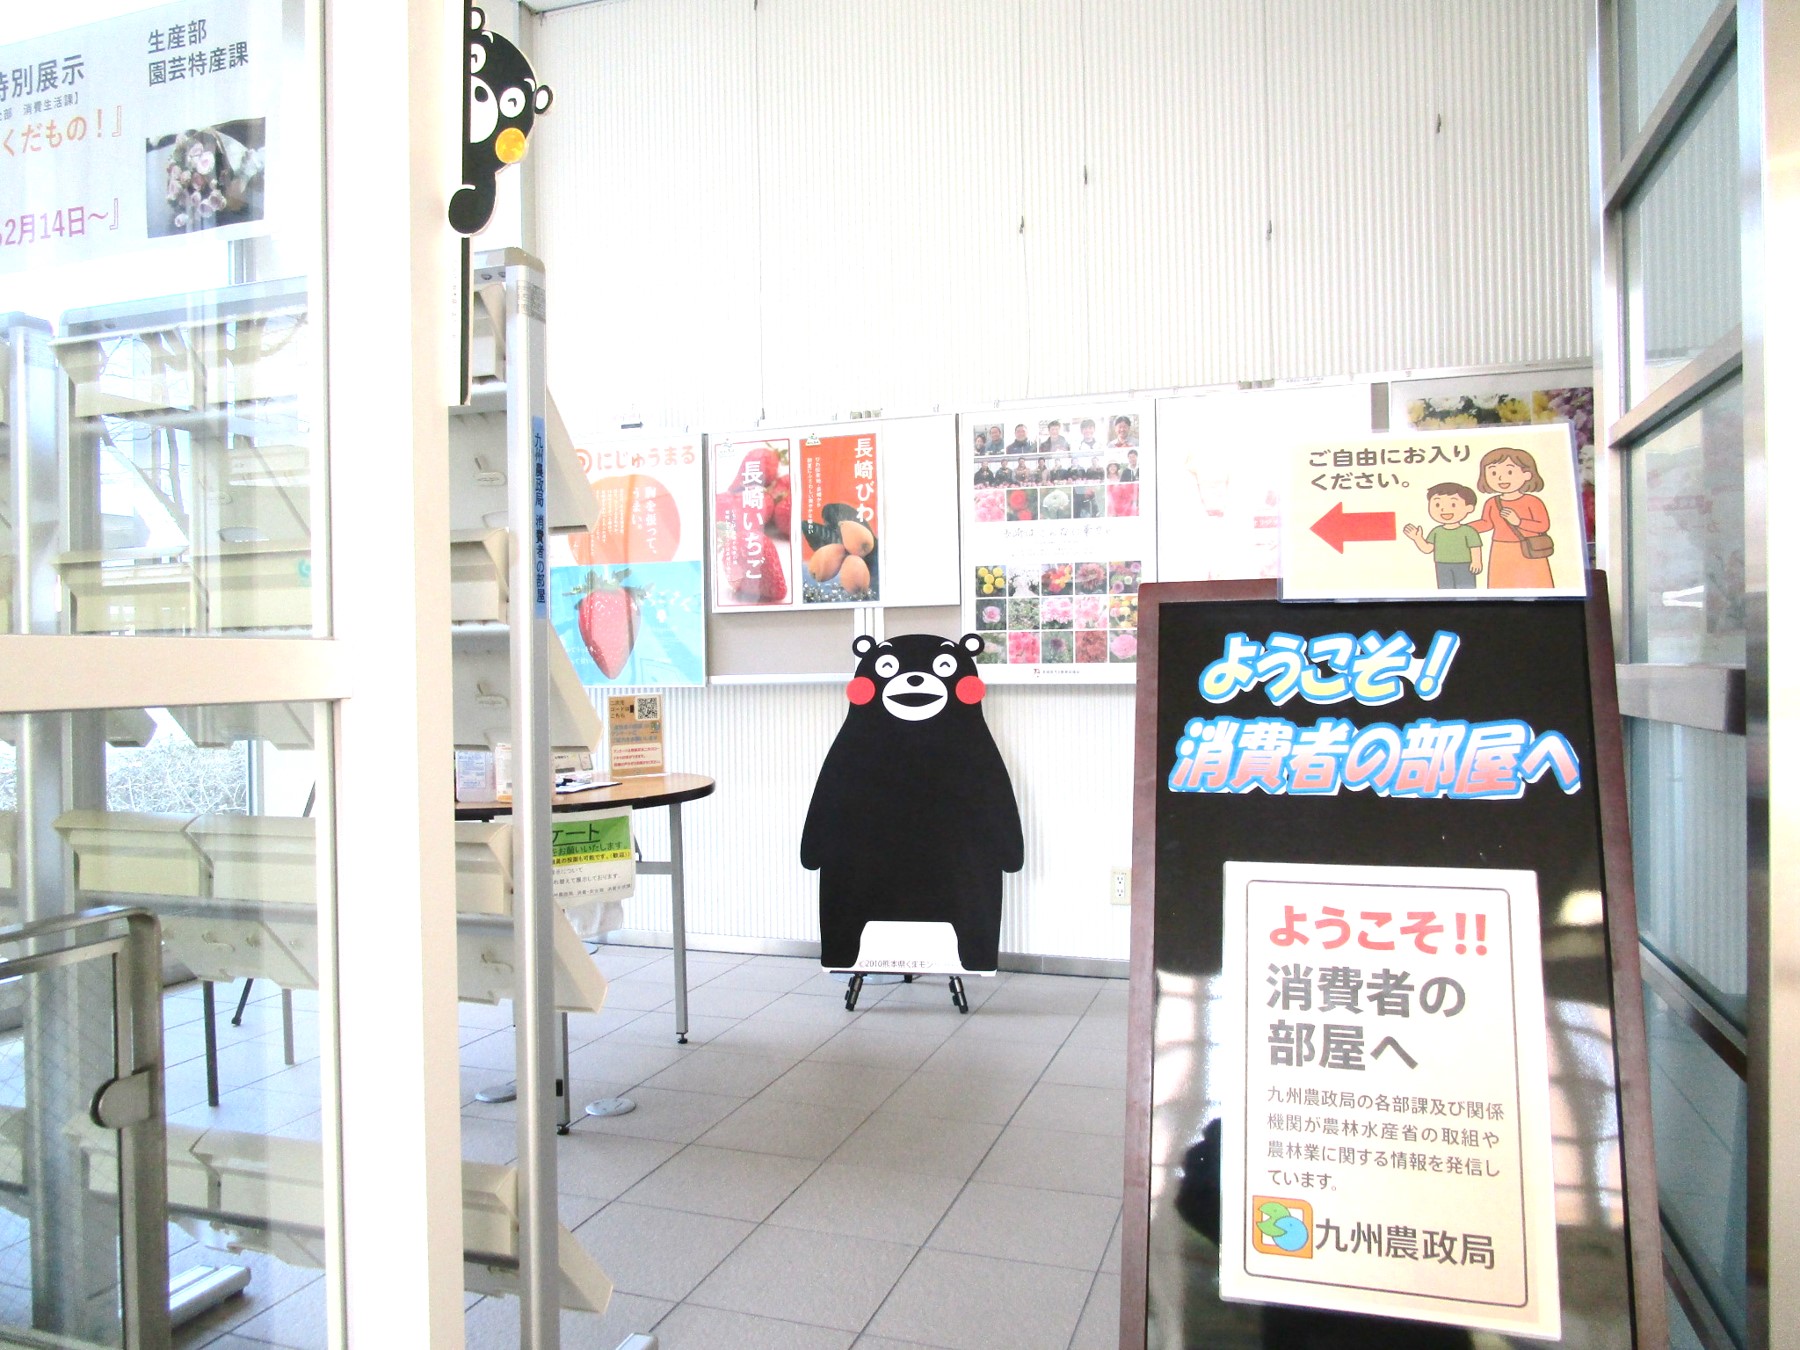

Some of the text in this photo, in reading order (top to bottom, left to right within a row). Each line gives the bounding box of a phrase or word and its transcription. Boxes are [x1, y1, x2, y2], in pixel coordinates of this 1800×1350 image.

[148, 18, 207, 54] 生産部
[148, 41, 249, 87] 園芸特産課
[0, 197, 119, 246] 2月14日～』
[597, 445, 696, 470] にじゅうまる
[854, 438, 875, 523] 長崎びわ
[1308, 445, 1471, 467] ご自由にお入り
[1310, 471, 1410, 491] ください。
[534, 433, 545, 603] 九州農政局 消費者の部屋
[741, 461, 766, 580] 長崎いちご
[1199, 630, 1460, 706] ようこそ！
[1168, 715, 1581, 799] 消費者の部屋へ
[1269, 905, 1488, 956] ようこそ!!
[1266, 963, 1466, 1018] 消費者の
[1267, 1019, 1419, 1071] 部屋へ
[1267, 1086, 1505, 1121] 九州農政局の各部課及び関係
[1267, 1113, 1500, 1149] 機関が農林水産省の取組や
[1267, 1140, 1501, 1177] 農林業に関する情報を発信し
[1267, 1169, 1338, 1191] ています。
[1315, 1217, 1496, 1270] 九州農政局
